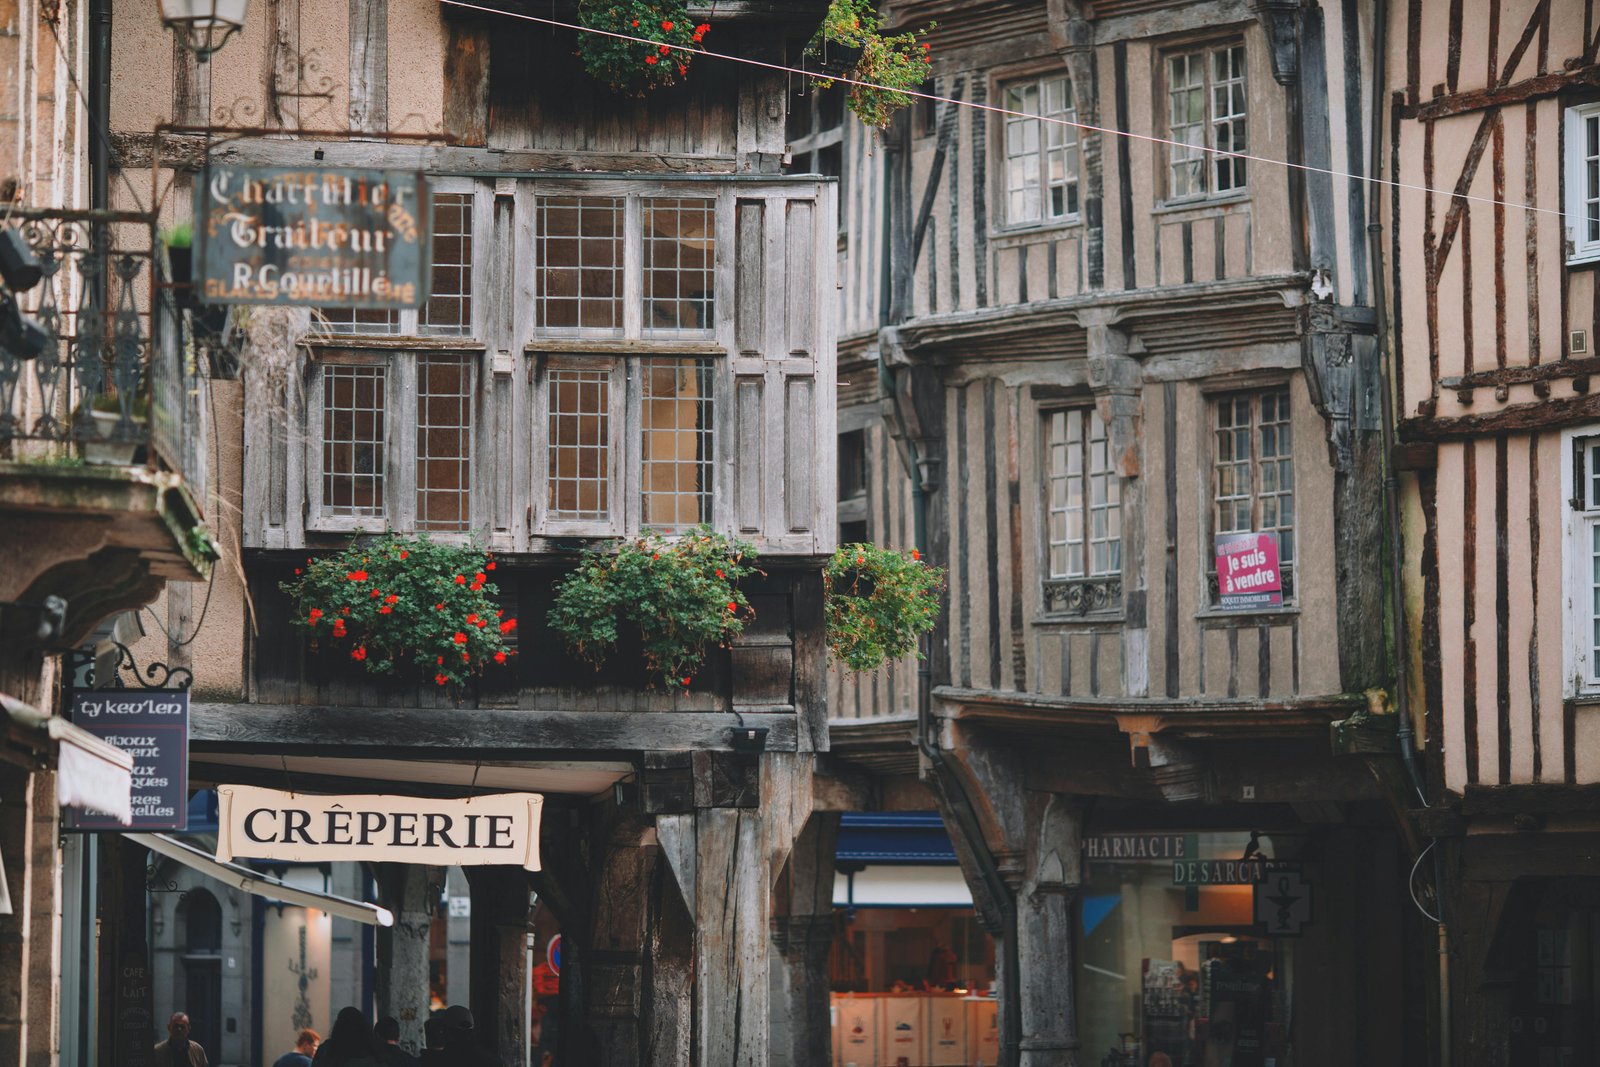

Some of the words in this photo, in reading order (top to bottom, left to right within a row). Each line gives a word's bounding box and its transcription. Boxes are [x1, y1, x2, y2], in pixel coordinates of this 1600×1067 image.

[1227, 555, 1240, 575] Je
[1240, 548, 1267, 569] suis
[1226, 575, 1234, 593] à
[1234, 568, 1275, 590] vendre
[243, 803, 515, 849] CRÊPERIE
[1081, 836, 1185, 857] HARMACIE
